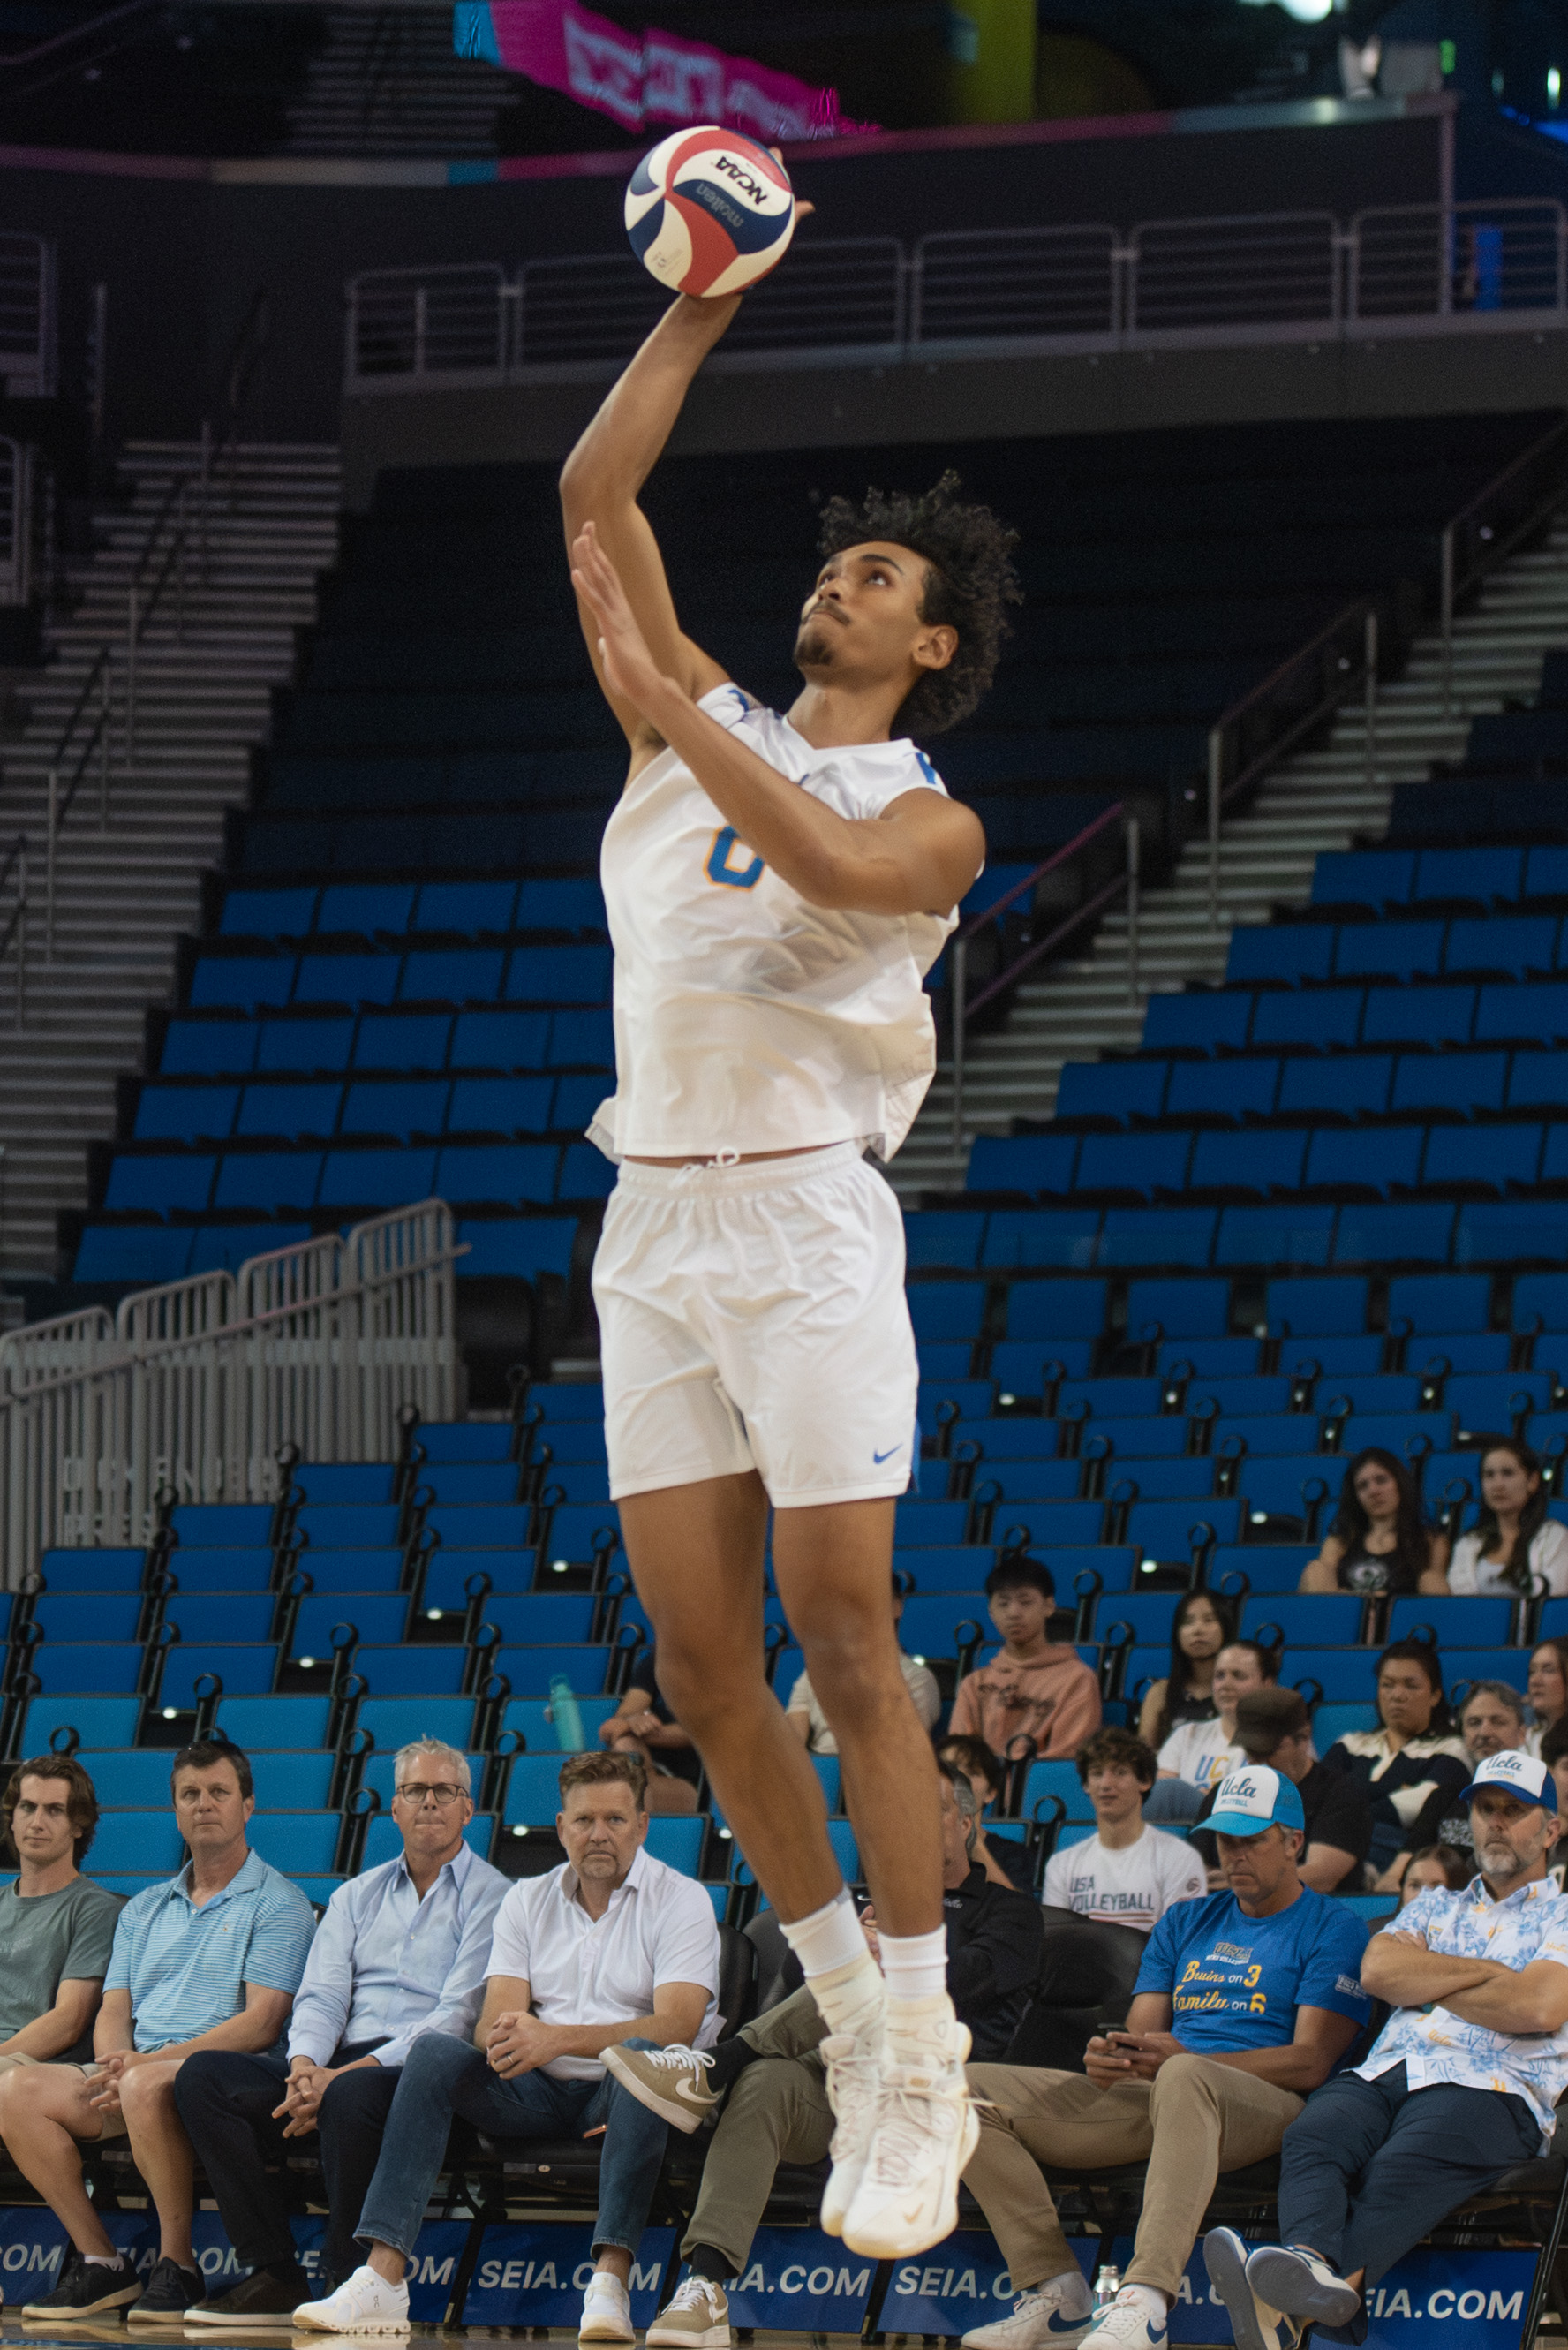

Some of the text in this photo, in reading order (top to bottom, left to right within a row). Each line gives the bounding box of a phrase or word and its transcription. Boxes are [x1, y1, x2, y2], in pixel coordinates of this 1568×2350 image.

[716, 156, 767, 205] NCAA
[696, 183, 743, 227] molten
[1221, 1776, 1256, 1799] Ucla
[1070, 1875, 1095, 1893] USA
[1068, 1893, 1155, 1912] VOLLEYBALL
[1182, 1961, 1262, 1988] Bruins on 3
[1232, 2001, 1247, 2011] on
[478, 2260, 661, 2292] SEIA.CM
